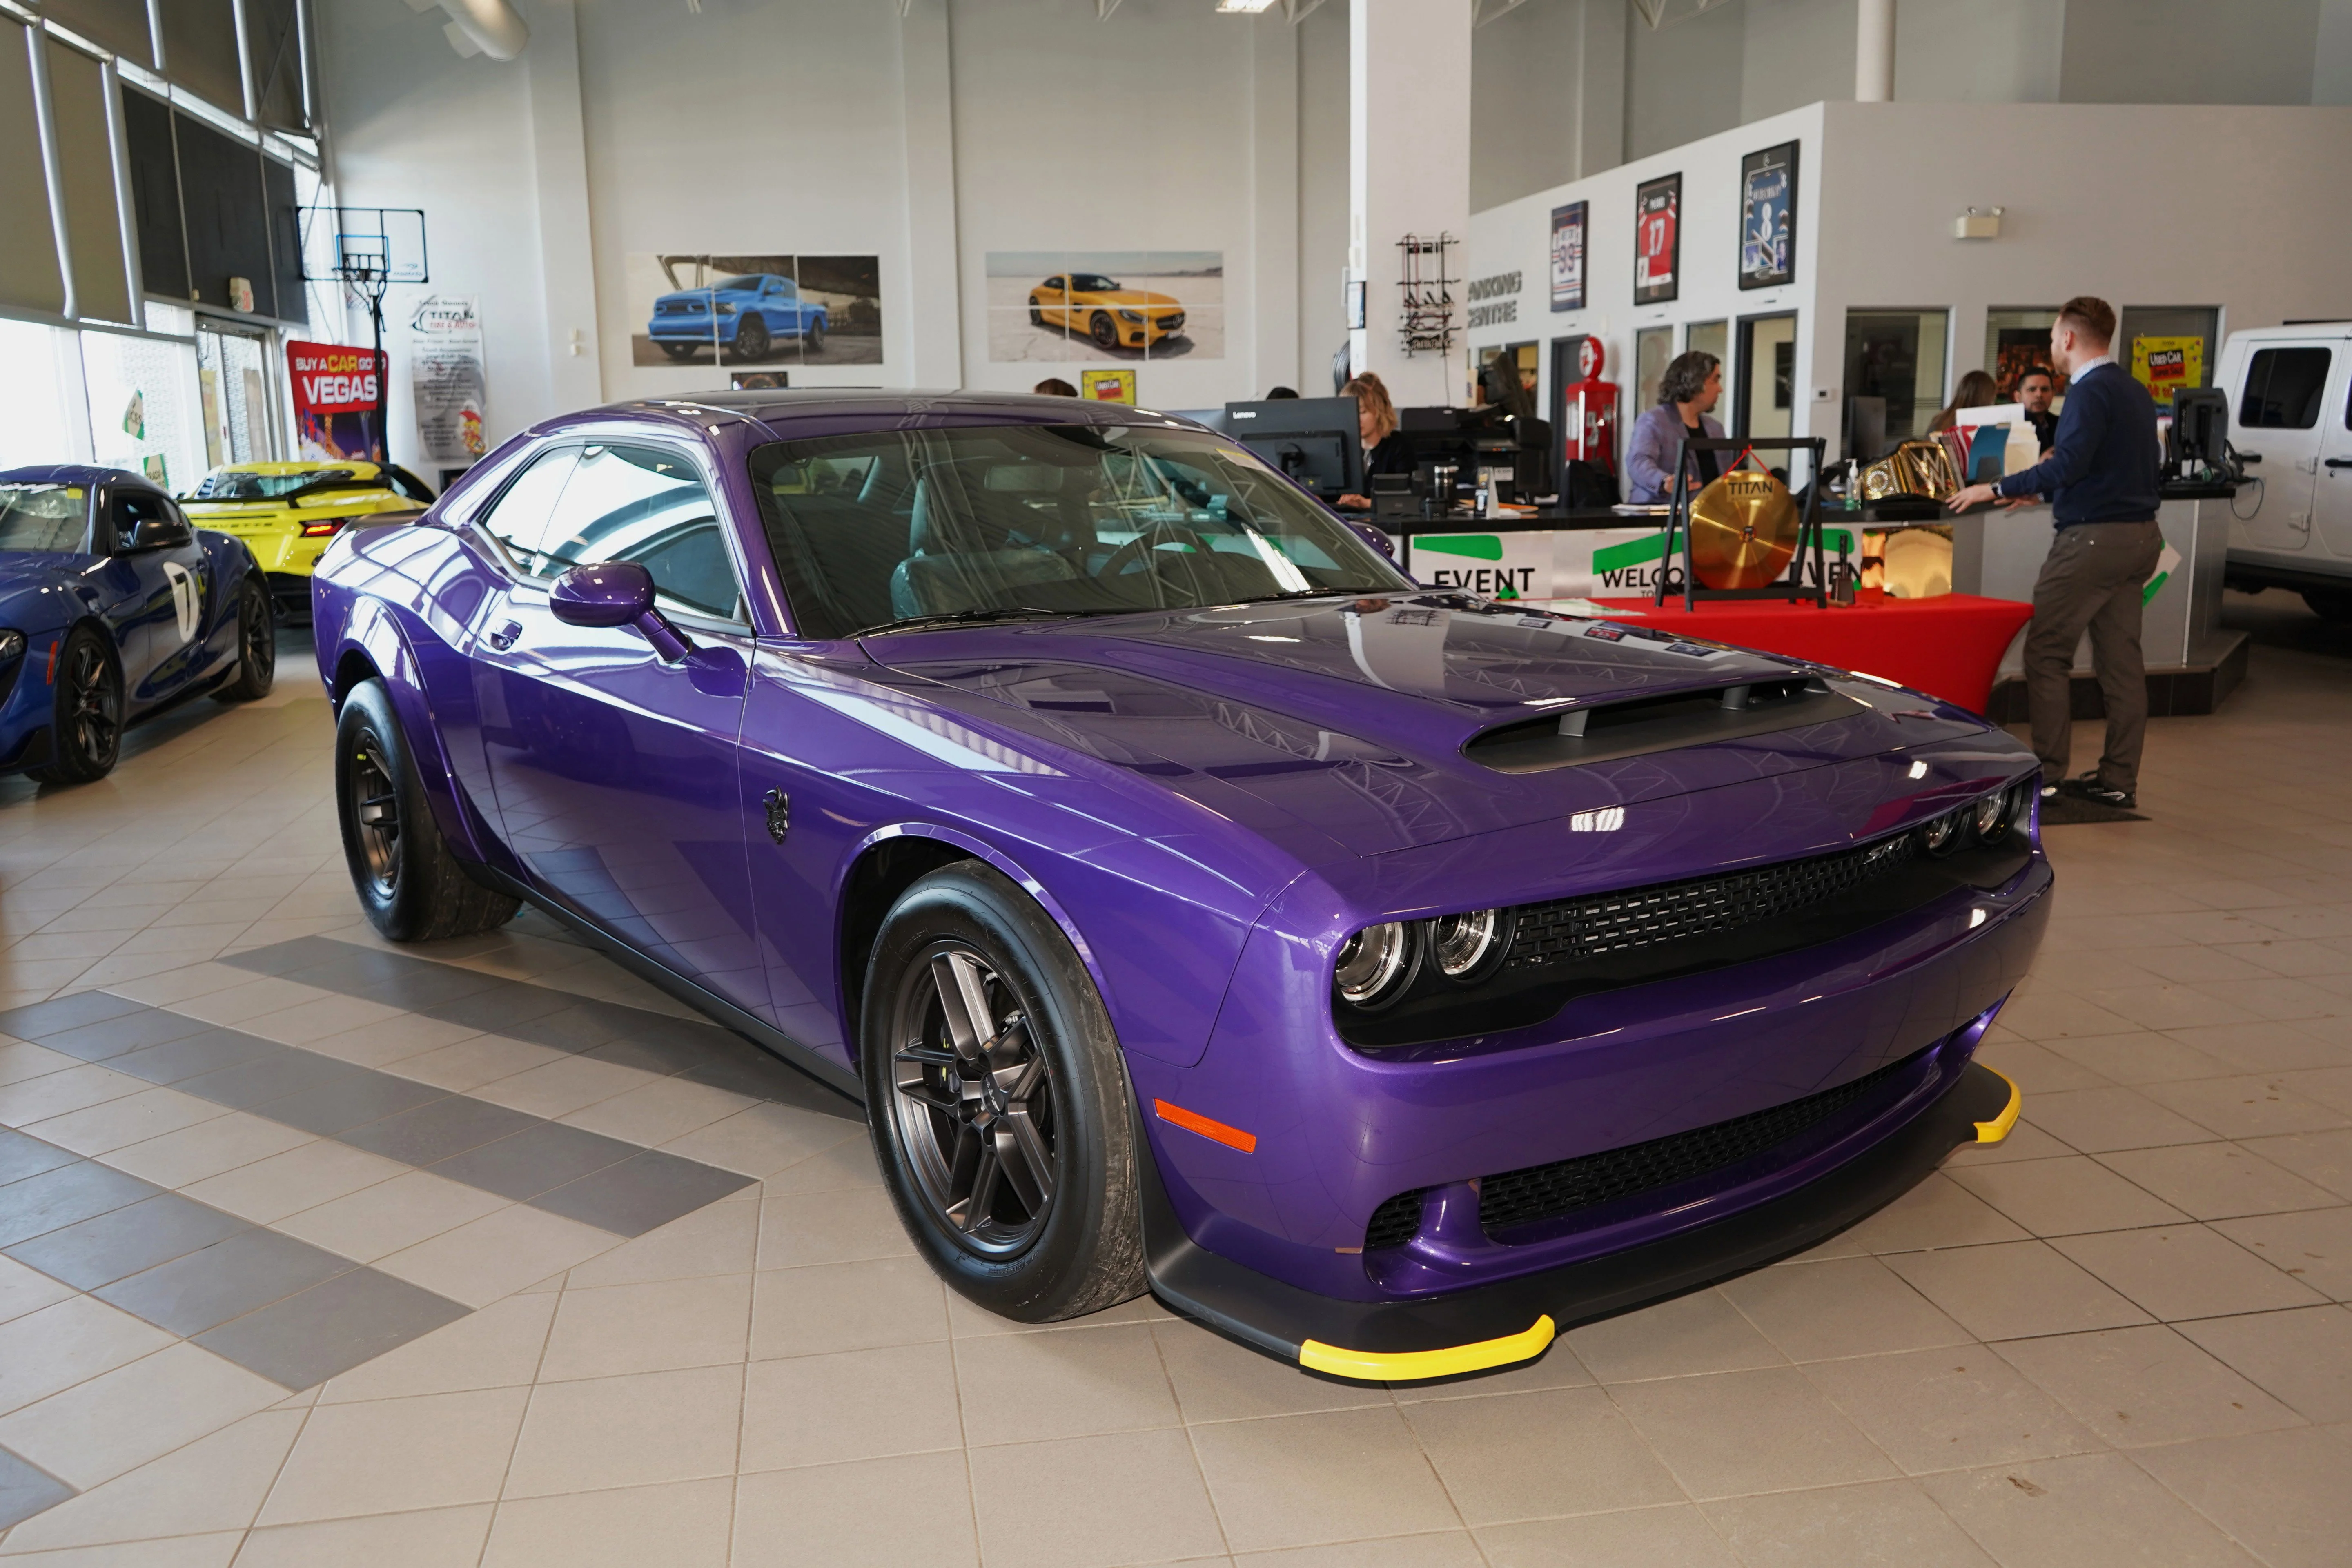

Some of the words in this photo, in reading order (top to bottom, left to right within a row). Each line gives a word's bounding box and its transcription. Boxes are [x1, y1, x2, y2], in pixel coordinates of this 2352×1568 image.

[1649, 218, 1665, 256] 17
[1762, 202, 1773, 241] 8
[1468, 271, 1522, 302] ANKING
[1468, 300, 1517, 329] ENTRE
[296, 357, 318, 371] BUY
[319, 357, 327, 370] A
[328, 354, 358, 373] CAR
[359, 357, 373, 371] GO
[302, 374, 378, 405] VEGAS
[1728, 481, 1773, 494] TITAN
[1435, 568, 1535, 593] EVENT
[1863, 833, 1909, 864] SRT
